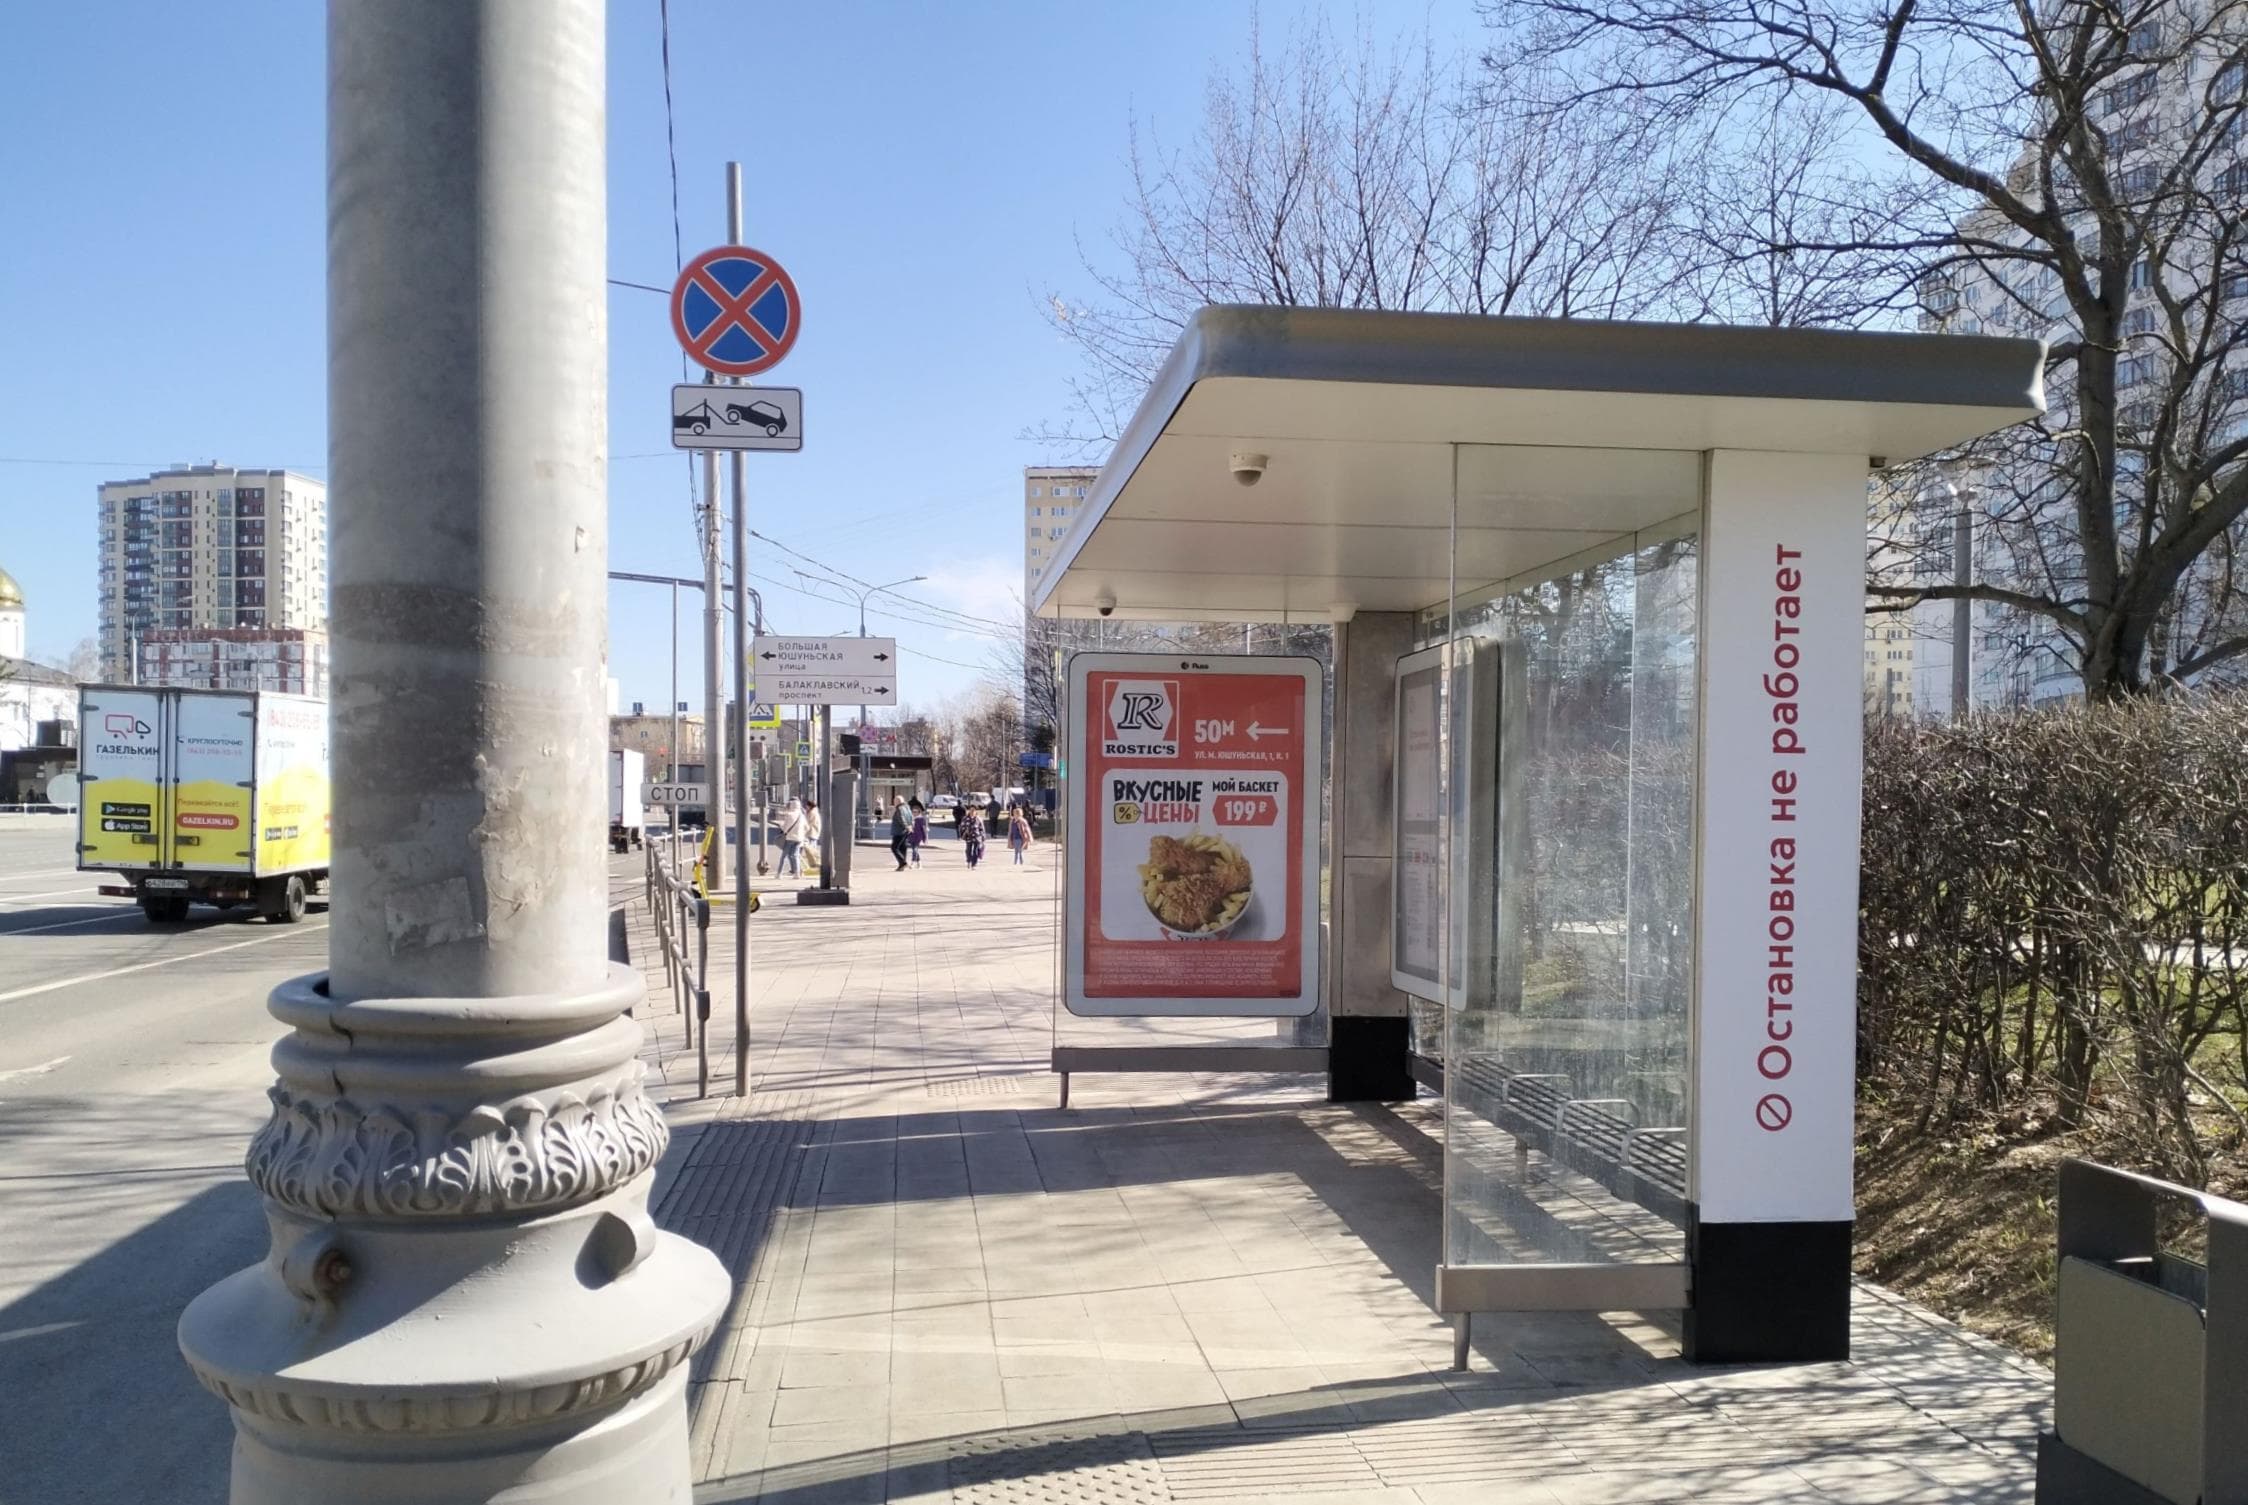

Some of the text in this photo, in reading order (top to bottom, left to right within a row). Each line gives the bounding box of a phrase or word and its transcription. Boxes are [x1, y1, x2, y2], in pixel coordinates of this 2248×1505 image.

[778, 642, 828, 651] БОЛЬШАЯ
[778, 652, 844, 661] ЮШУНЬСКАЯ
[778, 663, 806, 671] улица
[778, 679, 860, 690] БАЛАКЛАВСКИЙ
[778, 692, 822, 700] проспект
[96, 744, 160, 756] ГАЗЕЛЬКИН
[1105, 743, 1176, 756] ROSTIC'S
[1113, 779, 1203, 803] ВКУСНЫЕ
[1212, 778, 1279, 793] МОЙ БАСКЕТ
[650, 786, 698, 801] СТОП
[1143, 802, 1200, 824] ЦЕНЫ
[1757, 543, 1807, 1080] Остановка не работает
[116, 821, 149, 831] App Store
